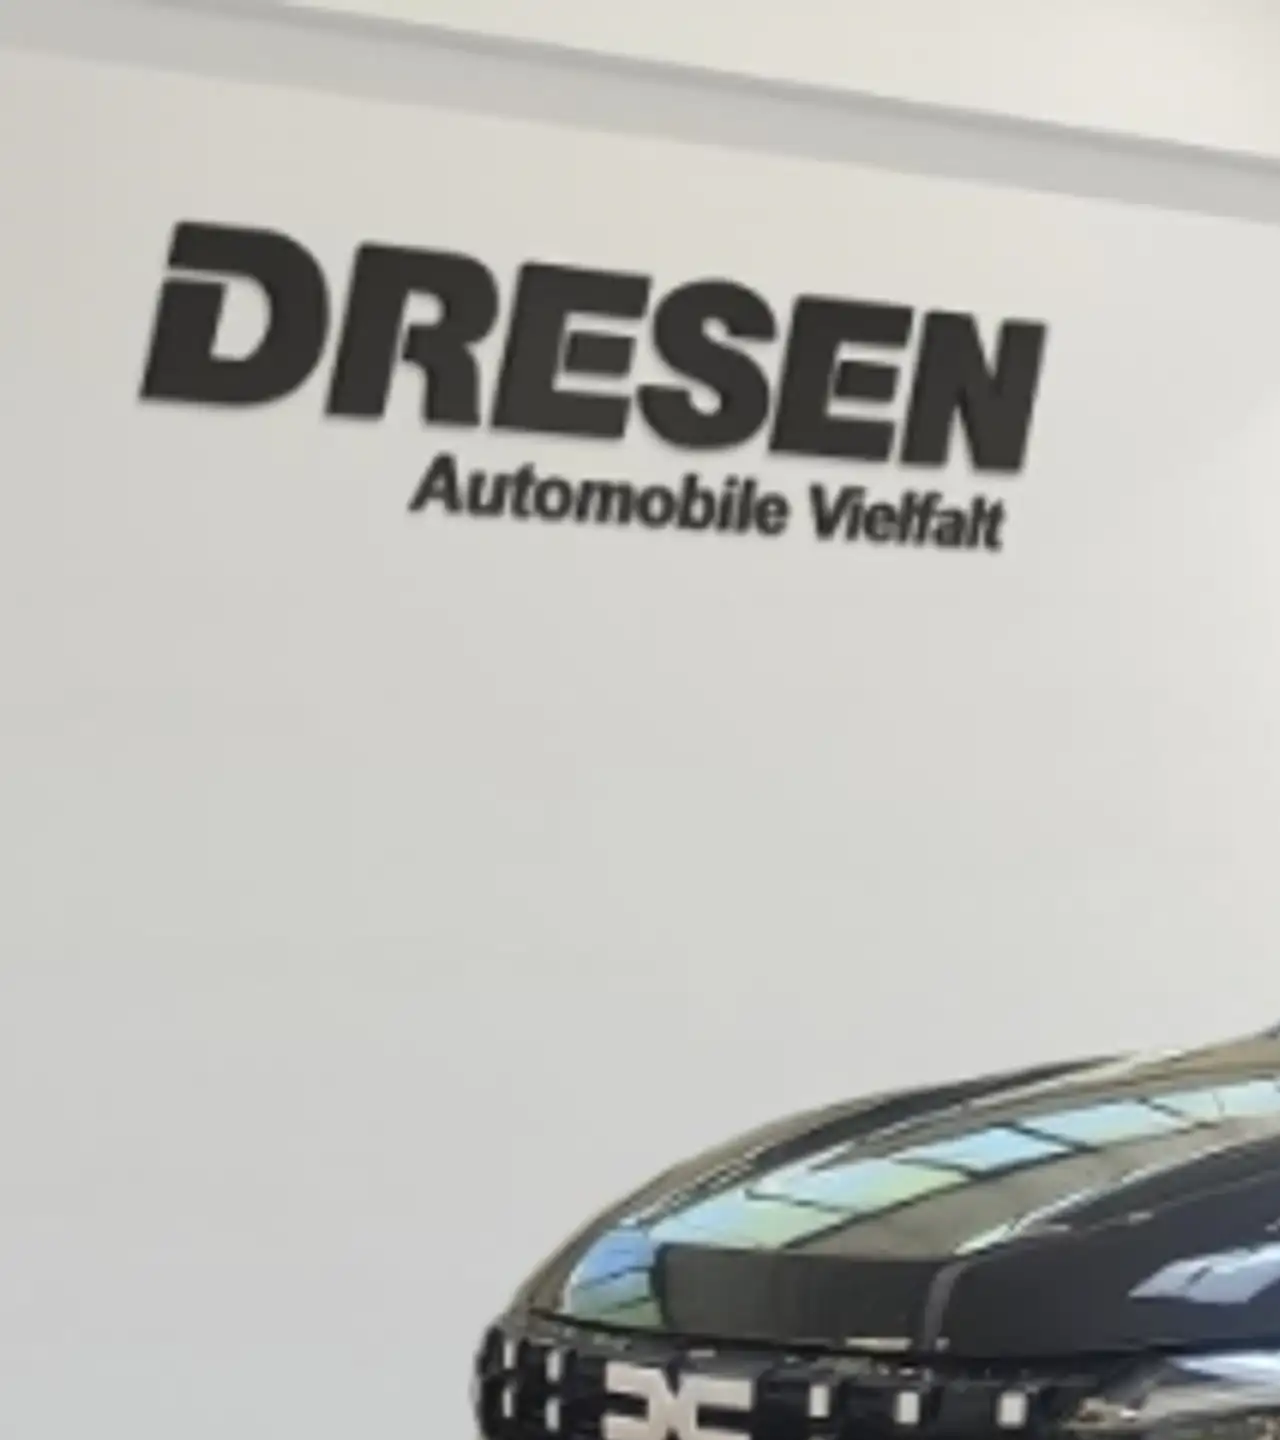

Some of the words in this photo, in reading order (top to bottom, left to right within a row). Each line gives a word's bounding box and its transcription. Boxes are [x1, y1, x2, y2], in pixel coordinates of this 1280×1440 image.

[139, 221, 1046, 474] DRESEN
[408, 454, 790, 536] Automobile
[808, 484, 1005, 551] Vielfalt
